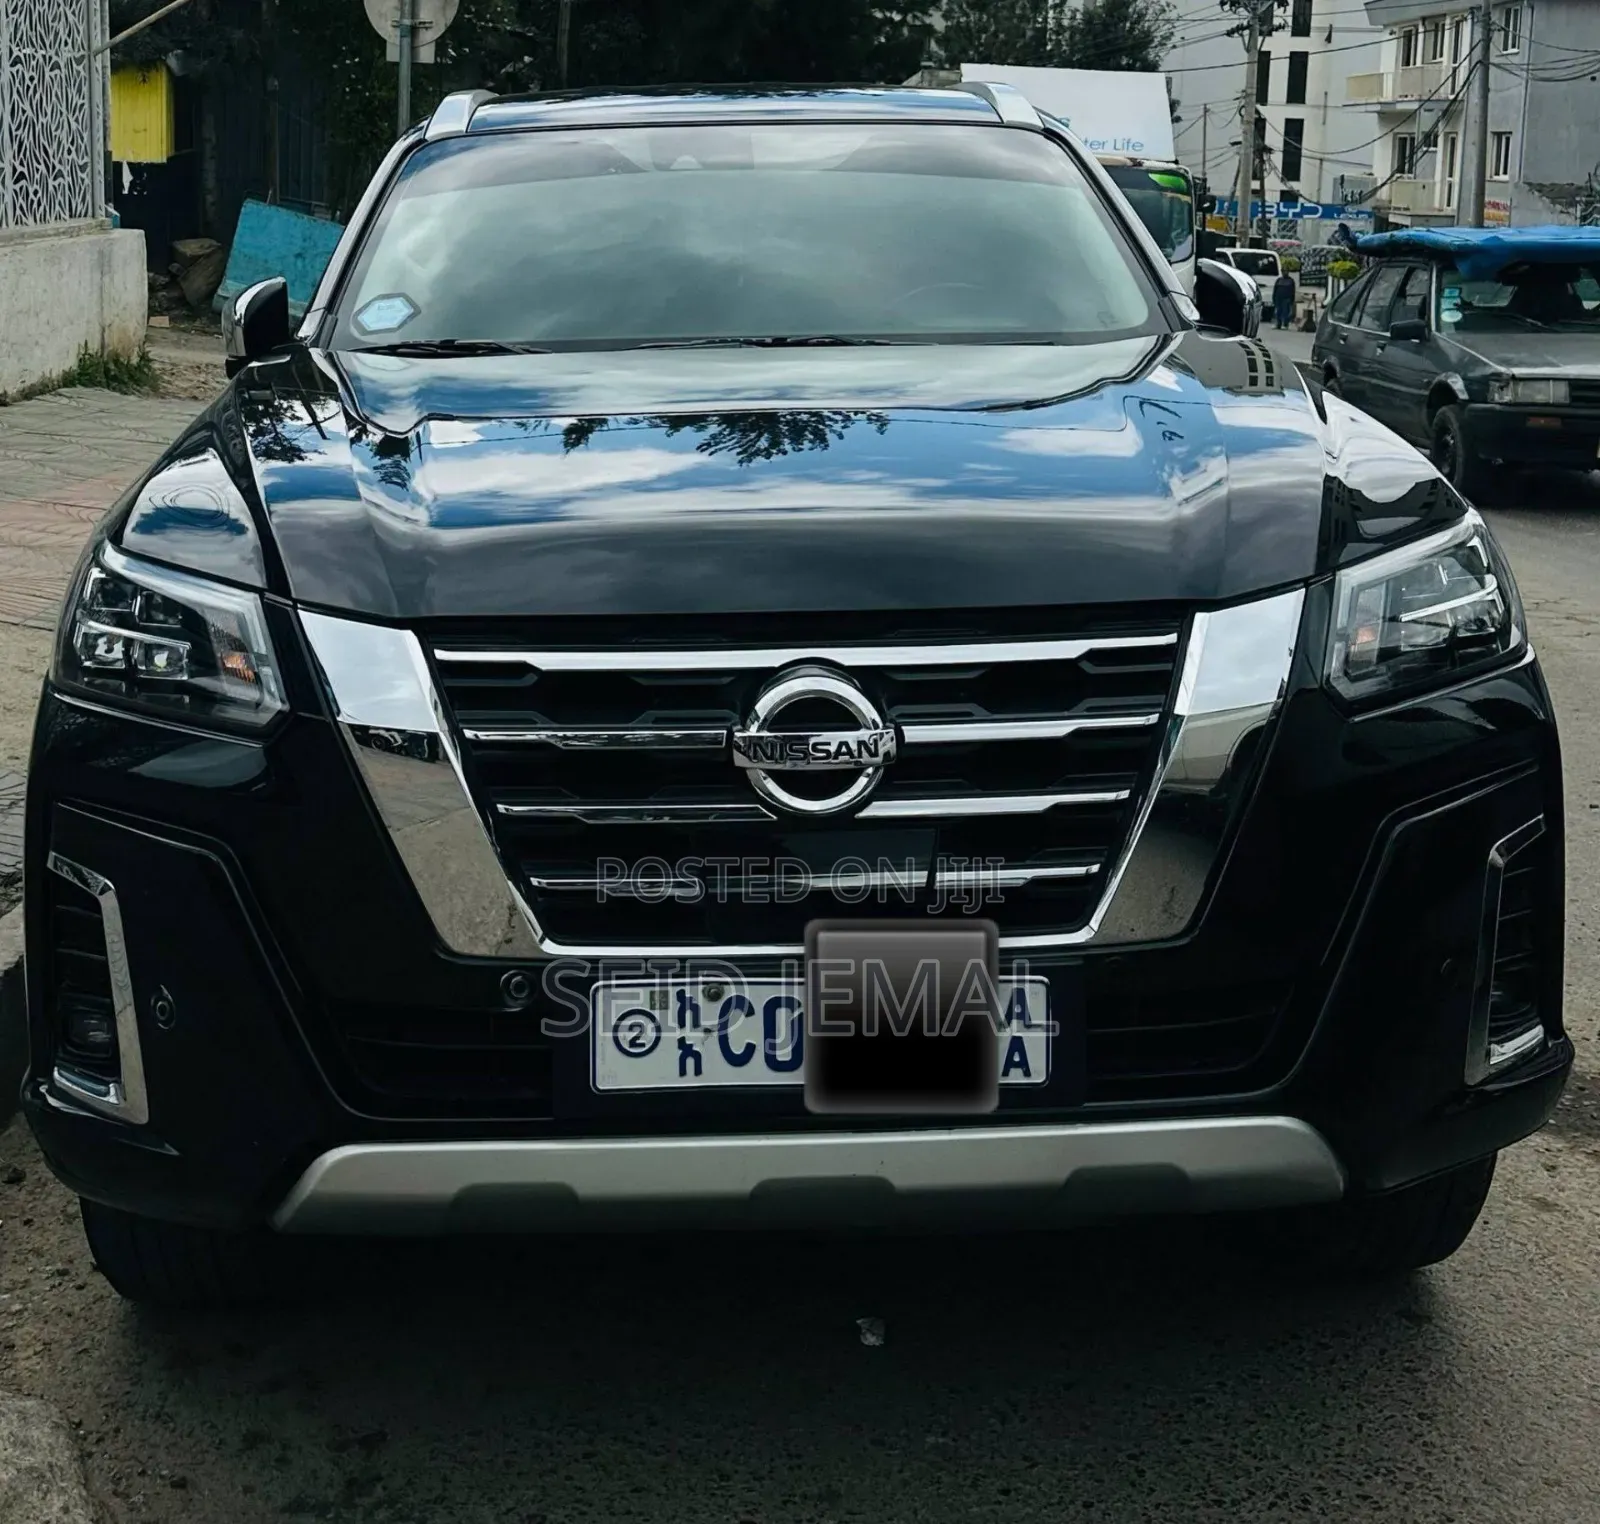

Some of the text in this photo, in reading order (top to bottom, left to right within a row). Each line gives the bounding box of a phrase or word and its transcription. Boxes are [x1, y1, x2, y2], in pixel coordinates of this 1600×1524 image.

[1082, 138, 1144, 152] ter Life
[1258, 202, 1322, 219] BYD
[752, 740, 880, 762] NISSAN
[1003, 987, 1032, 1028] A
[1001, 1035, 1031, 1078] A
